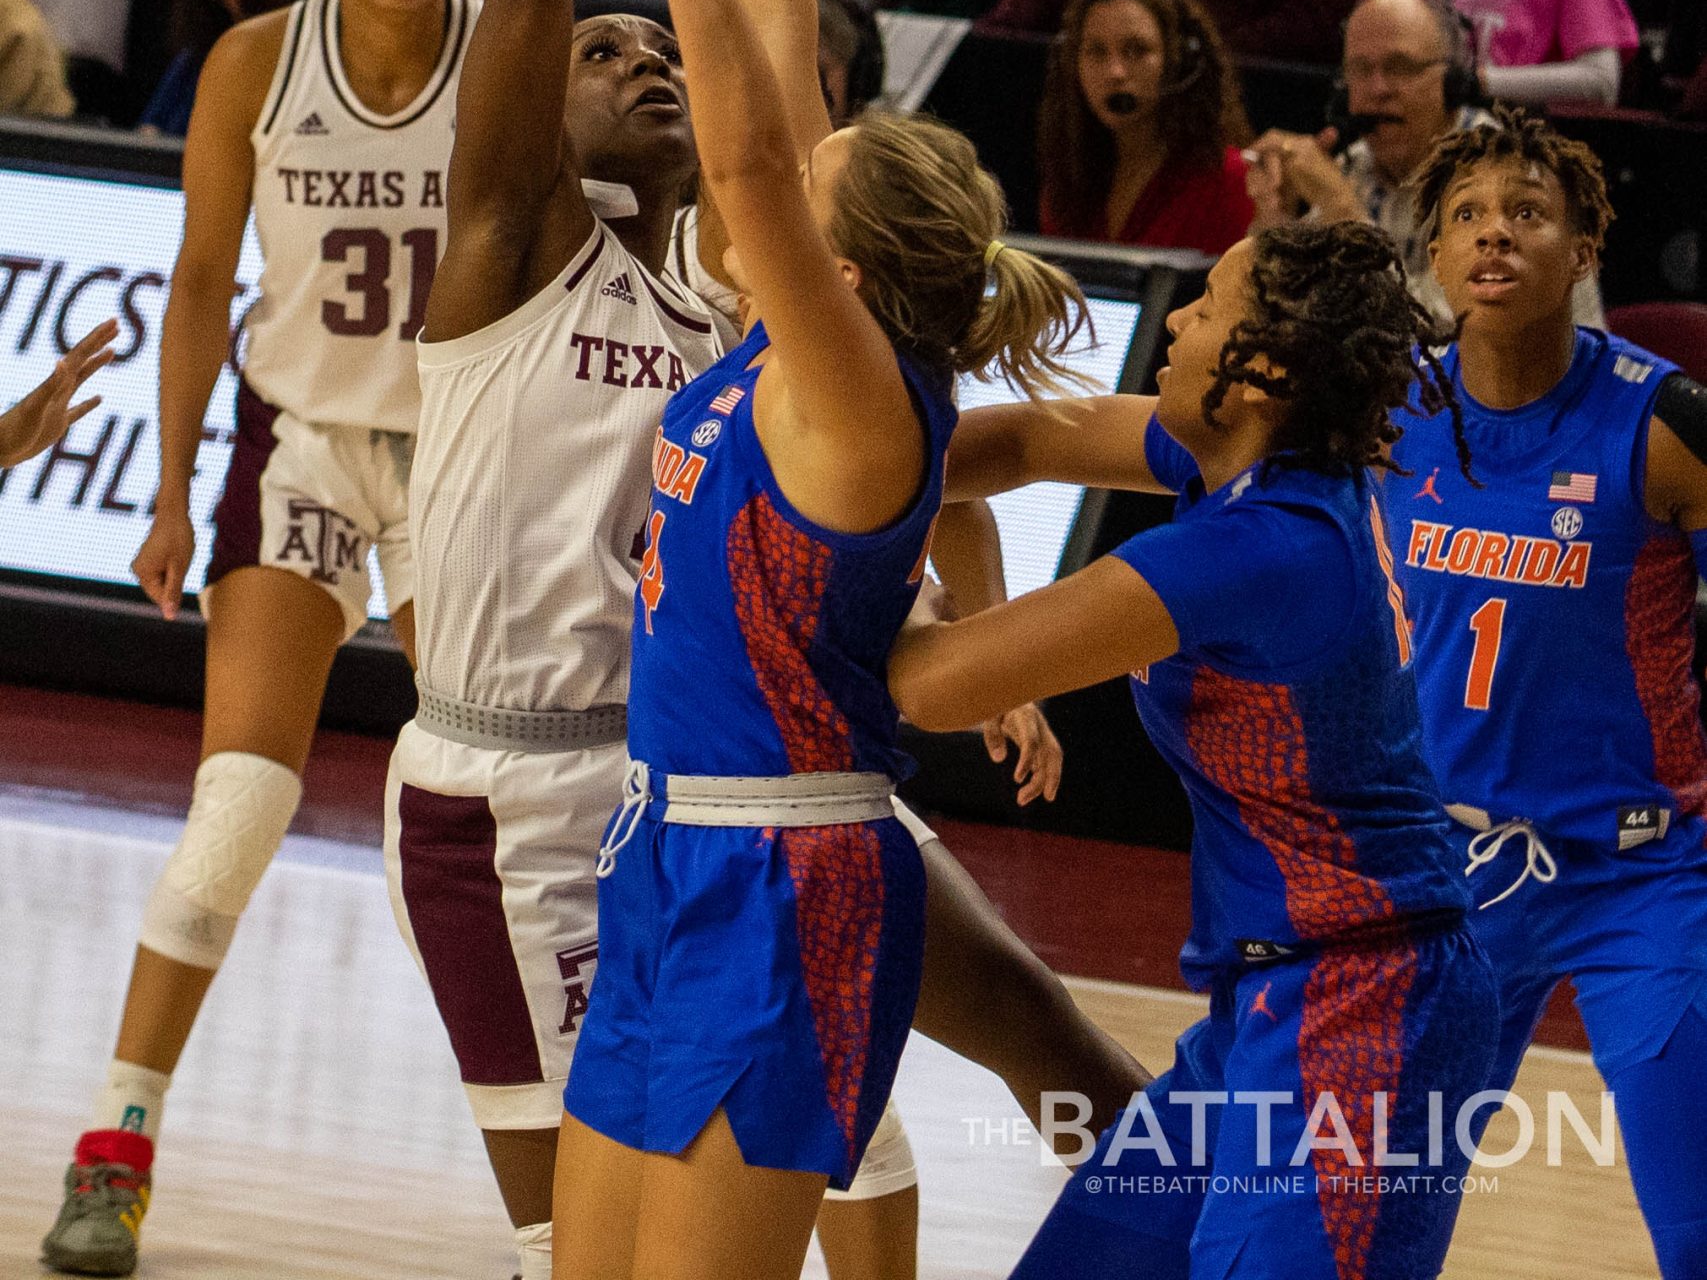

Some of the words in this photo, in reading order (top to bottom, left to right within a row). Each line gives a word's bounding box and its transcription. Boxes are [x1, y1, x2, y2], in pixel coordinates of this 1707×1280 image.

[278, 168, 405, 208] TEXAS
[321, 227, 438, 342] 31
[601, 286, 637, 306] adidas
[570, 332, 687, 392] TEXA
[1552, 507, 1582, 538] SEC
[1405, 519, 1593, 589] FLORIDA
[1464, 597, 1507, 711] 1
[1625, 810, 1650, 827] 44
[1246, 943, 1267, 955] 46
